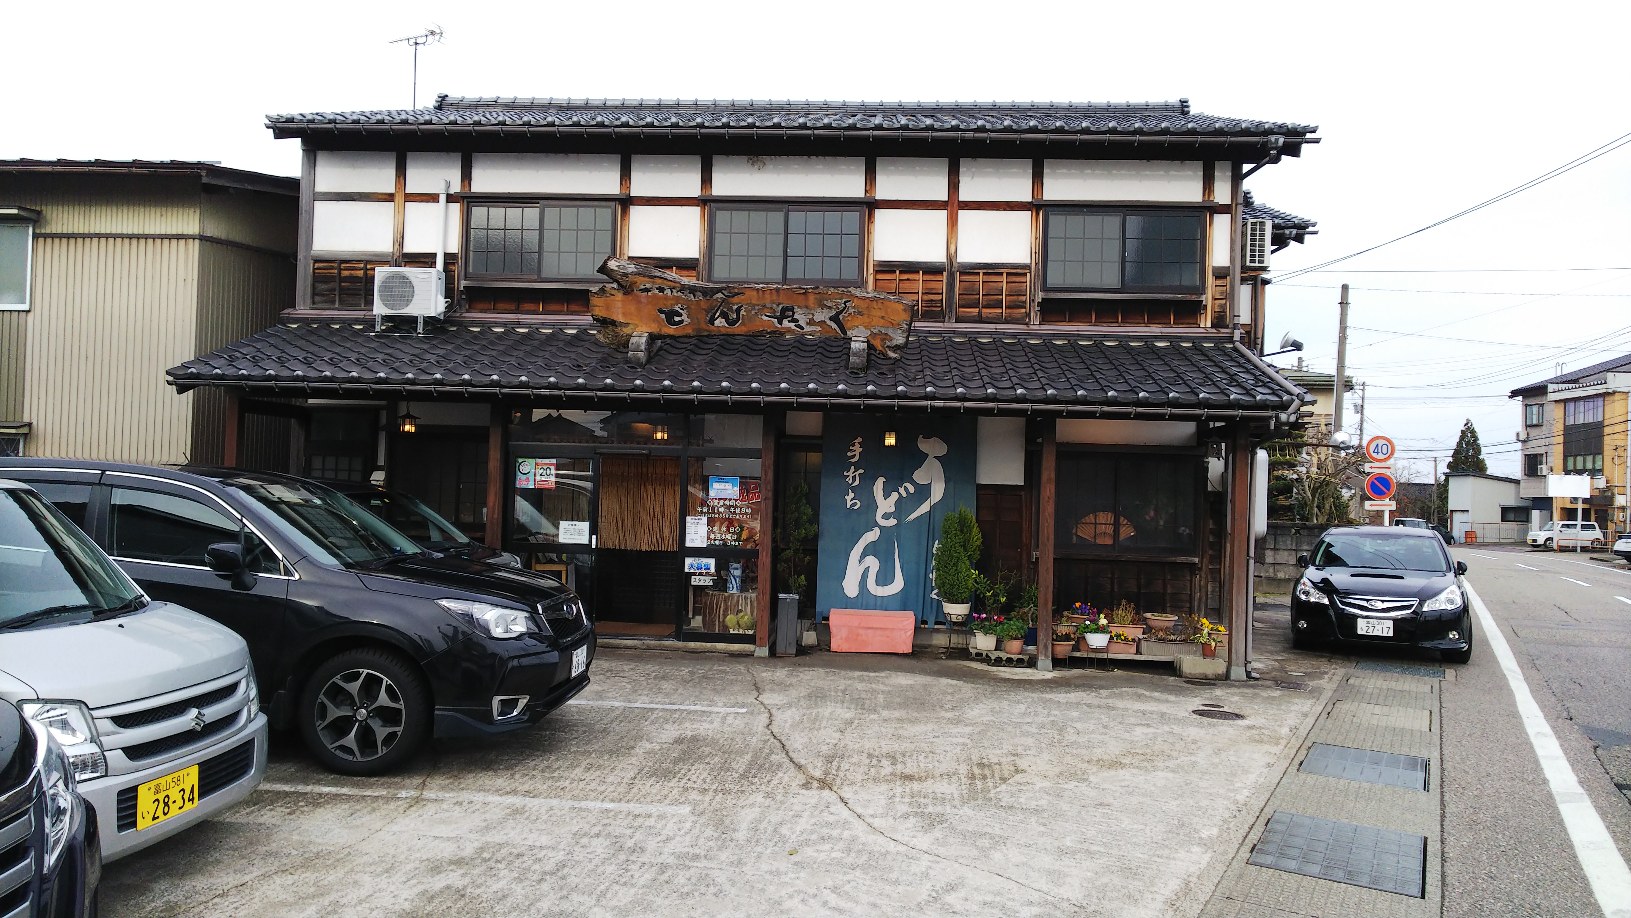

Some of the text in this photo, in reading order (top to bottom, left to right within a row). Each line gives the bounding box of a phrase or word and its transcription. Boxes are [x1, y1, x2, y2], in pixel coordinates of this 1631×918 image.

[843, 436, 865, 510] 手打ち
[1373, 443, 1389, 456] 40
[842, 434, 948, 599] うどん
[152, 783, 195, 822] 28-34
